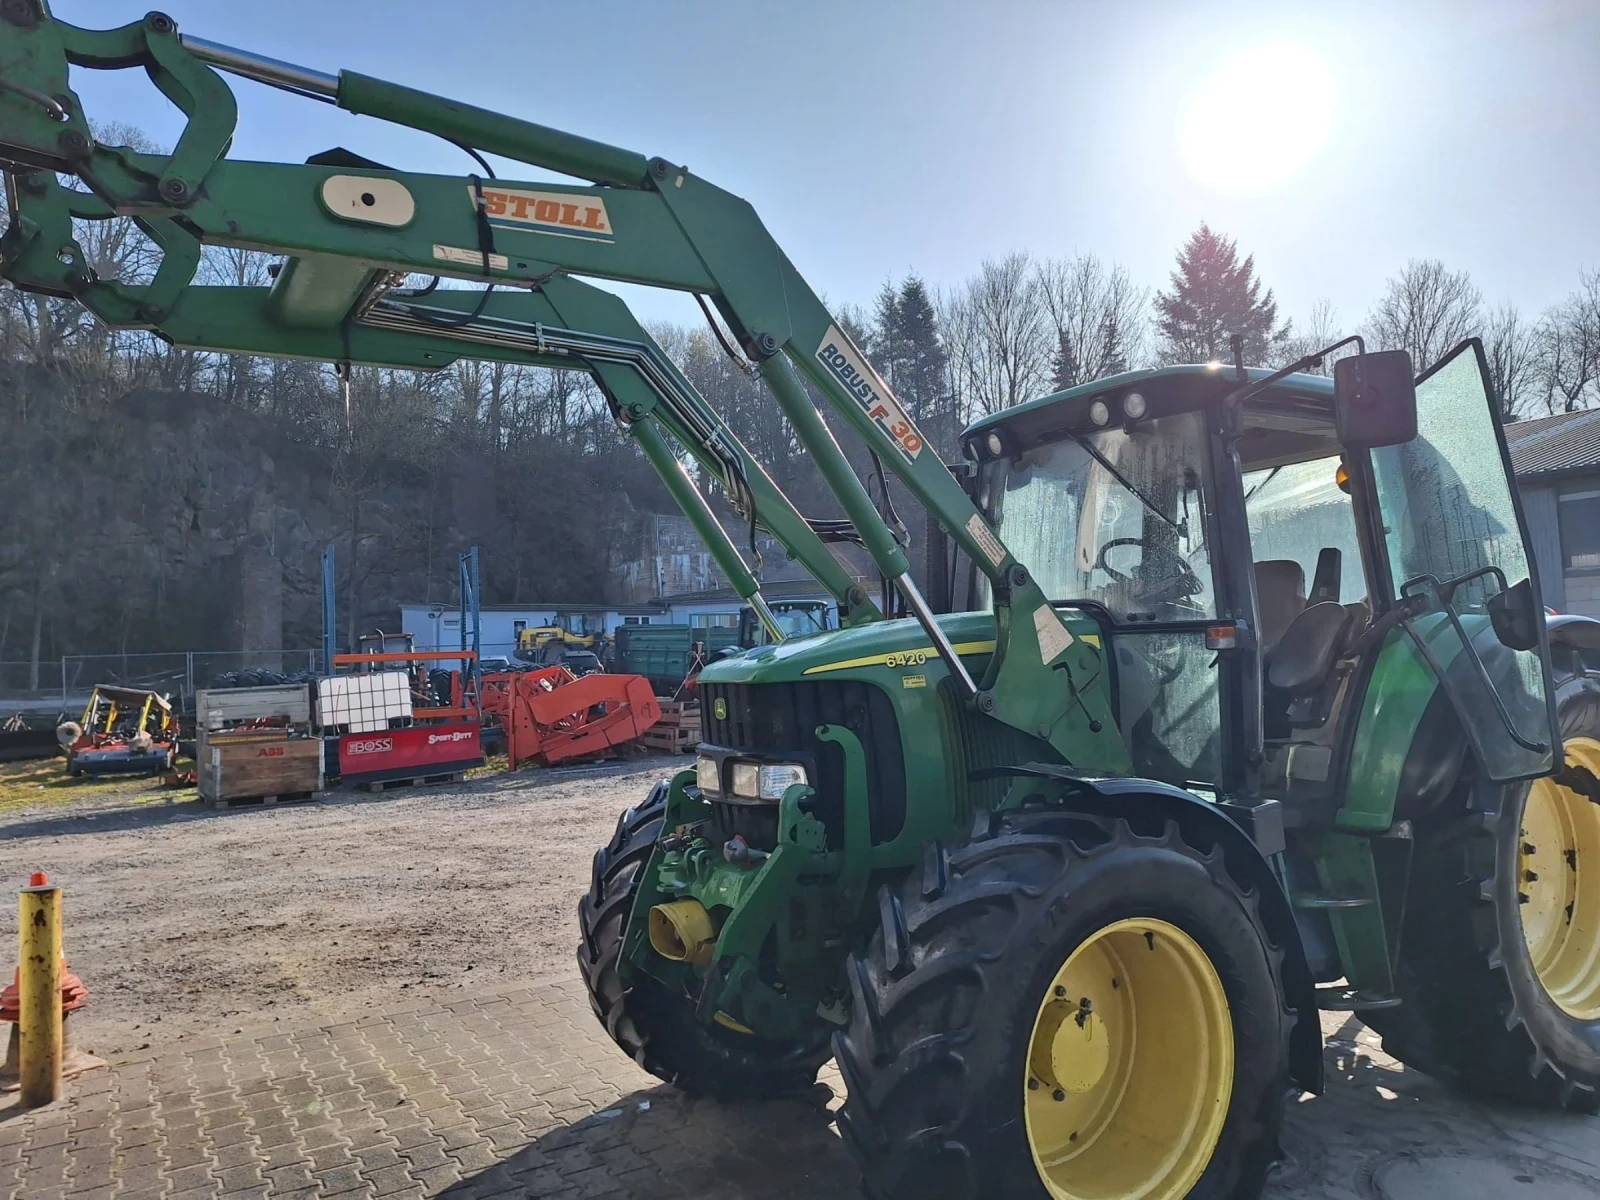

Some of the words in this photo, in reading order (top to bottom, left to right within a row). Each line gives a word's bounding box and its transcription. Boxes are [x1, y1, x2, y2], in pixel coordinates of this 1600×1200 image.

[484, 191, 604, 230] STOLL
[821, 342, 881, 405] ROBUST
[891, 421, 921, 451] 30
[886, 652, 925, 667] 6420
[256, 747, 284, 757] ABB
[356, 739, 391, 753] BOSS
